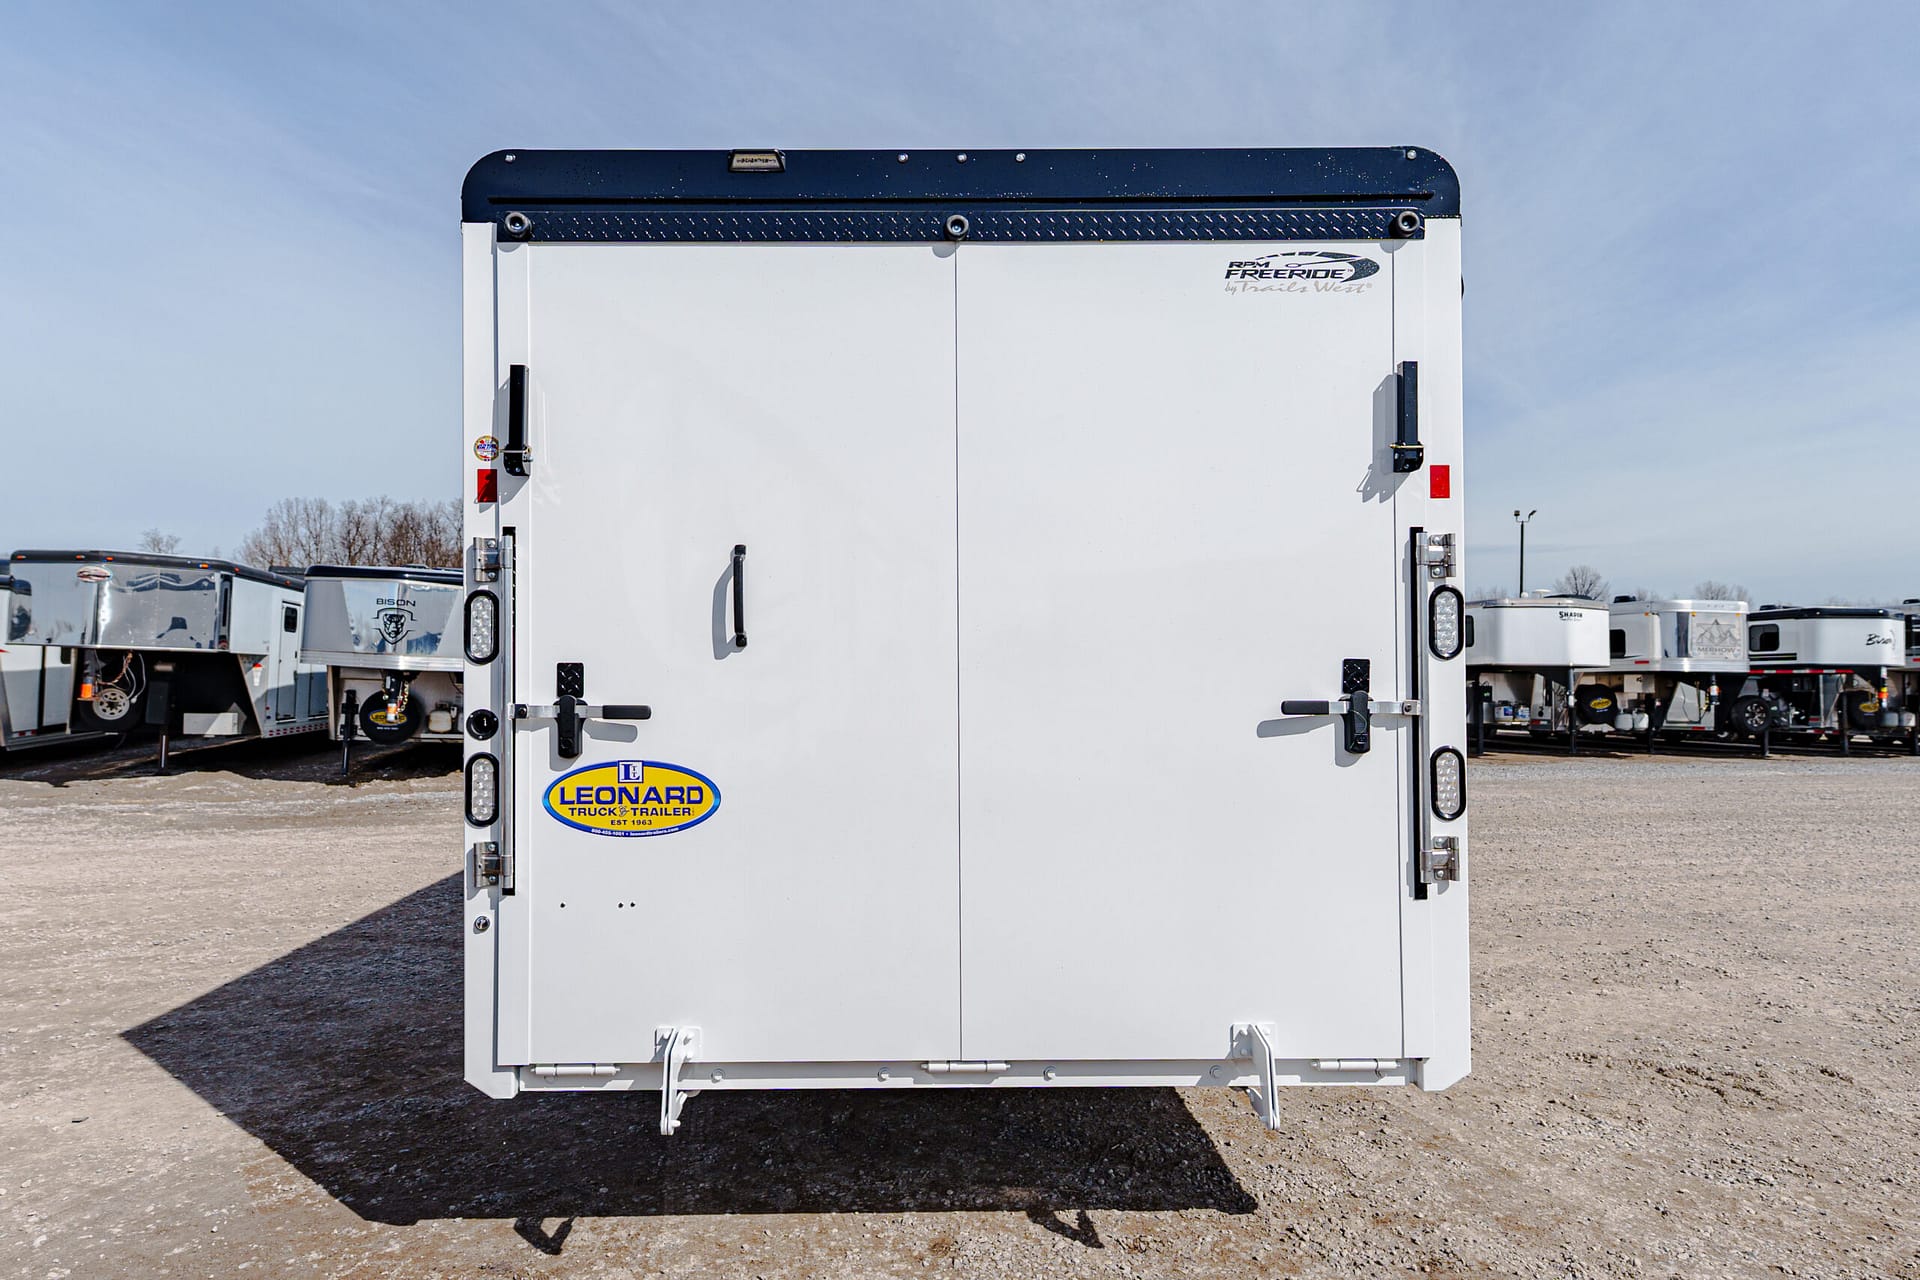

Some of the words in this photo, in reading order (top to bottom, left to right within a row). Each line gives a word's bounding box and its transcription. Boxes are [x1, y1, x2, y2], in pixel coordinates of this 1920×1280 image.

[1224, 269, 1346, 281] FREERIDE
[1224, 283, 1242, 296] by
[1235, 280, 1306, 293] Trails
[376, 598, 416, 607] BISON
[559, 786, 704, 805] LEONARD
[568, 807, 617, 817] TRUCK
[630, 807, 691, 817] TRAILER
